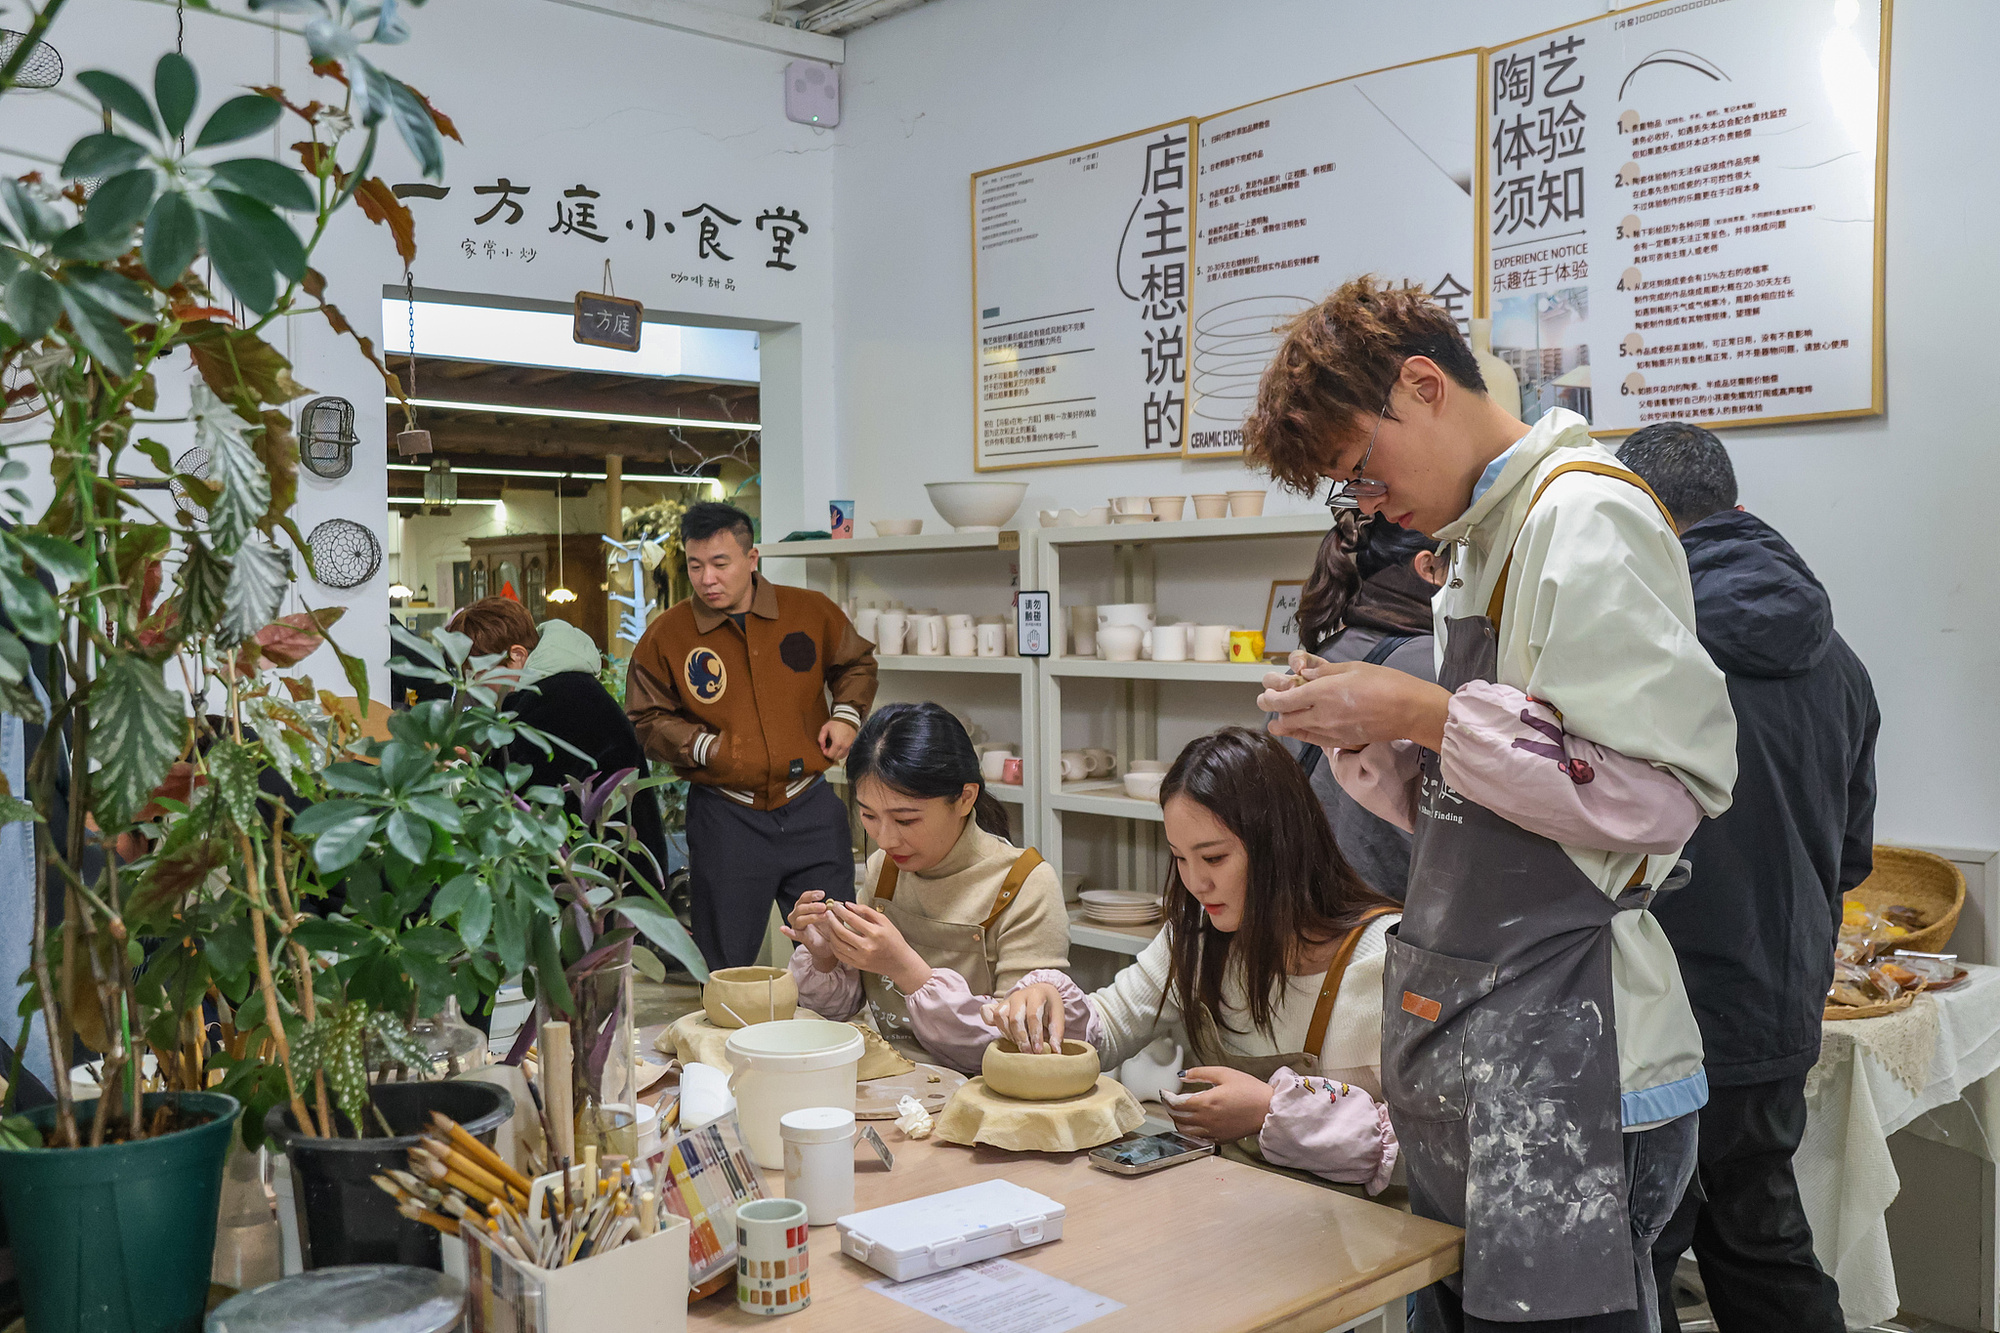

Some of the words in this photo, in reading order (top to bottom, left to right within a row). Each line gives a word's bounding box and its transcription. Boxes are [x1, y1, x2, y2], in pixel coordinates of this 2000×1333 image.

[1494, 35, 1586, 115] 陶艺
[1492, 100, 1586, 175] 体验
[1494, 167, 1585, 236] 须知
[391, 178, 809, 271] 一方庭小食堂
[460, 238, 538, 263] 家常小炒
[1494, 250, 1548, 270] EXPERIENCE
[1552, 243, 1588, 259] NOTICE
[670, 272, 737, 292] 咖啡甜品
[1493, 260, 1588, 292] 乐趣在于体验
[1141, 134, 1187, 449] 店主想说的
[583, 308, 632, 338] 一方庭
[1192, 432, 1222, 448] CERAMIC
[1025, 600, 1041, 610] 请勿
[1025, 611, 1041, 622] 触碰
[1434, 810, 1462, 824] Finding
